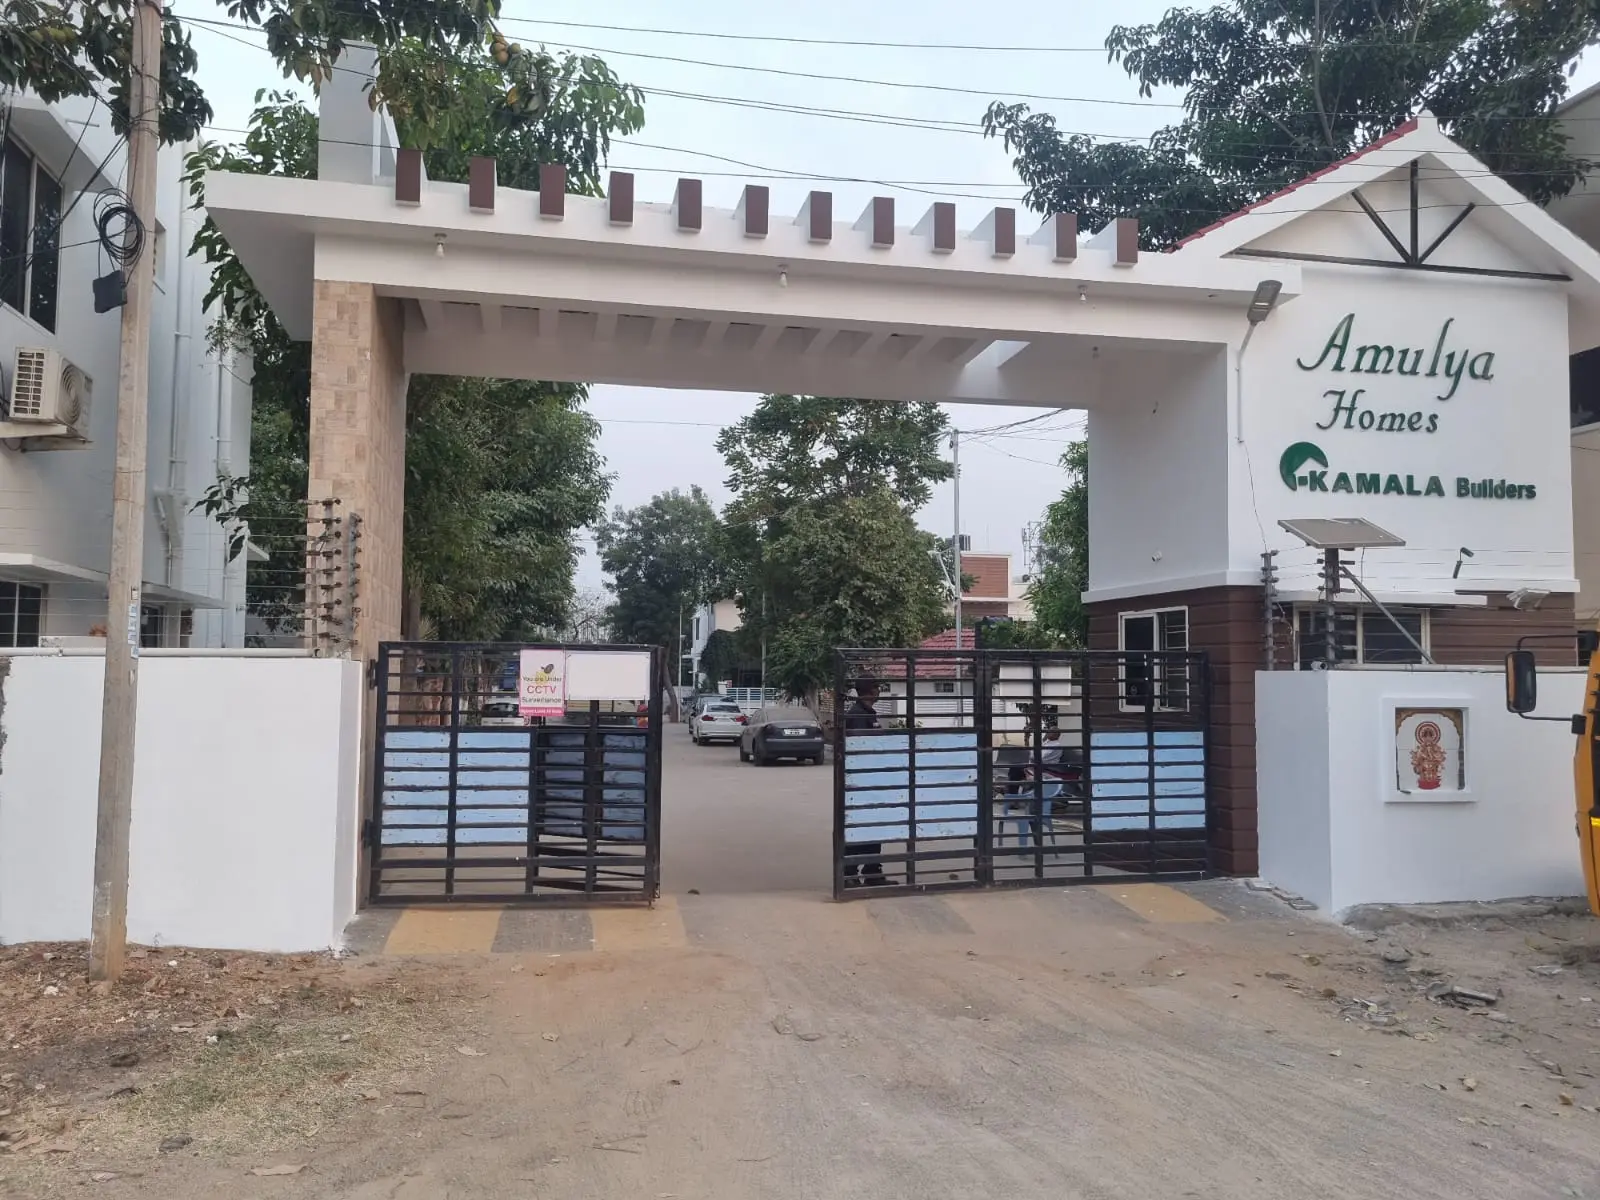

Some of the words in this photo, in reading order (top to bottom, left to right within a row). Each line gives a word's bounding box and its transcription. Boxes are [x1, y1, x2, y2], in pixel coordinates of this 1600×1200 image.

[1297, 313, 1495, 401] Amulya
[1316, 389, 1438, 433] Homes
[1308, 470, 1445, 497] KAMALA
[1456, 477, 1537, 499] Builders
[526, 685, 557, 694] CCTV
